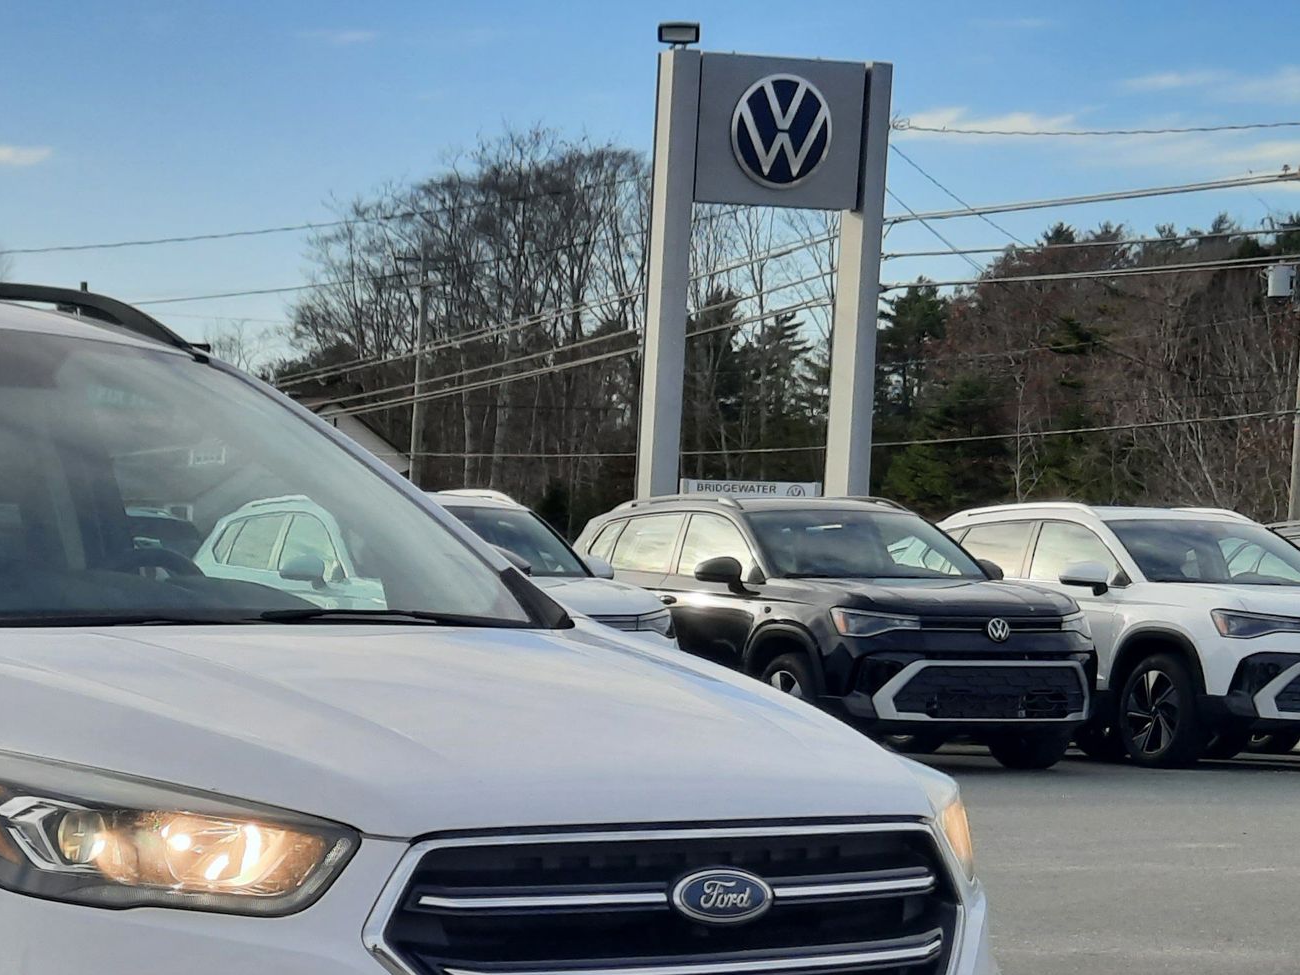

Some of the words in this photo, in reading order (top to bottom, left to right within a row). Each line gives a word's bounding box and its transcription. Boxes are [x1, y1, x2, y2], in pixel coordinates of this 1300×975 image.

[733, 75, 831, 187] VW
[696, 482, 777, 495] BRIDGEWATER
[700, 880, 751, 909] Ford
